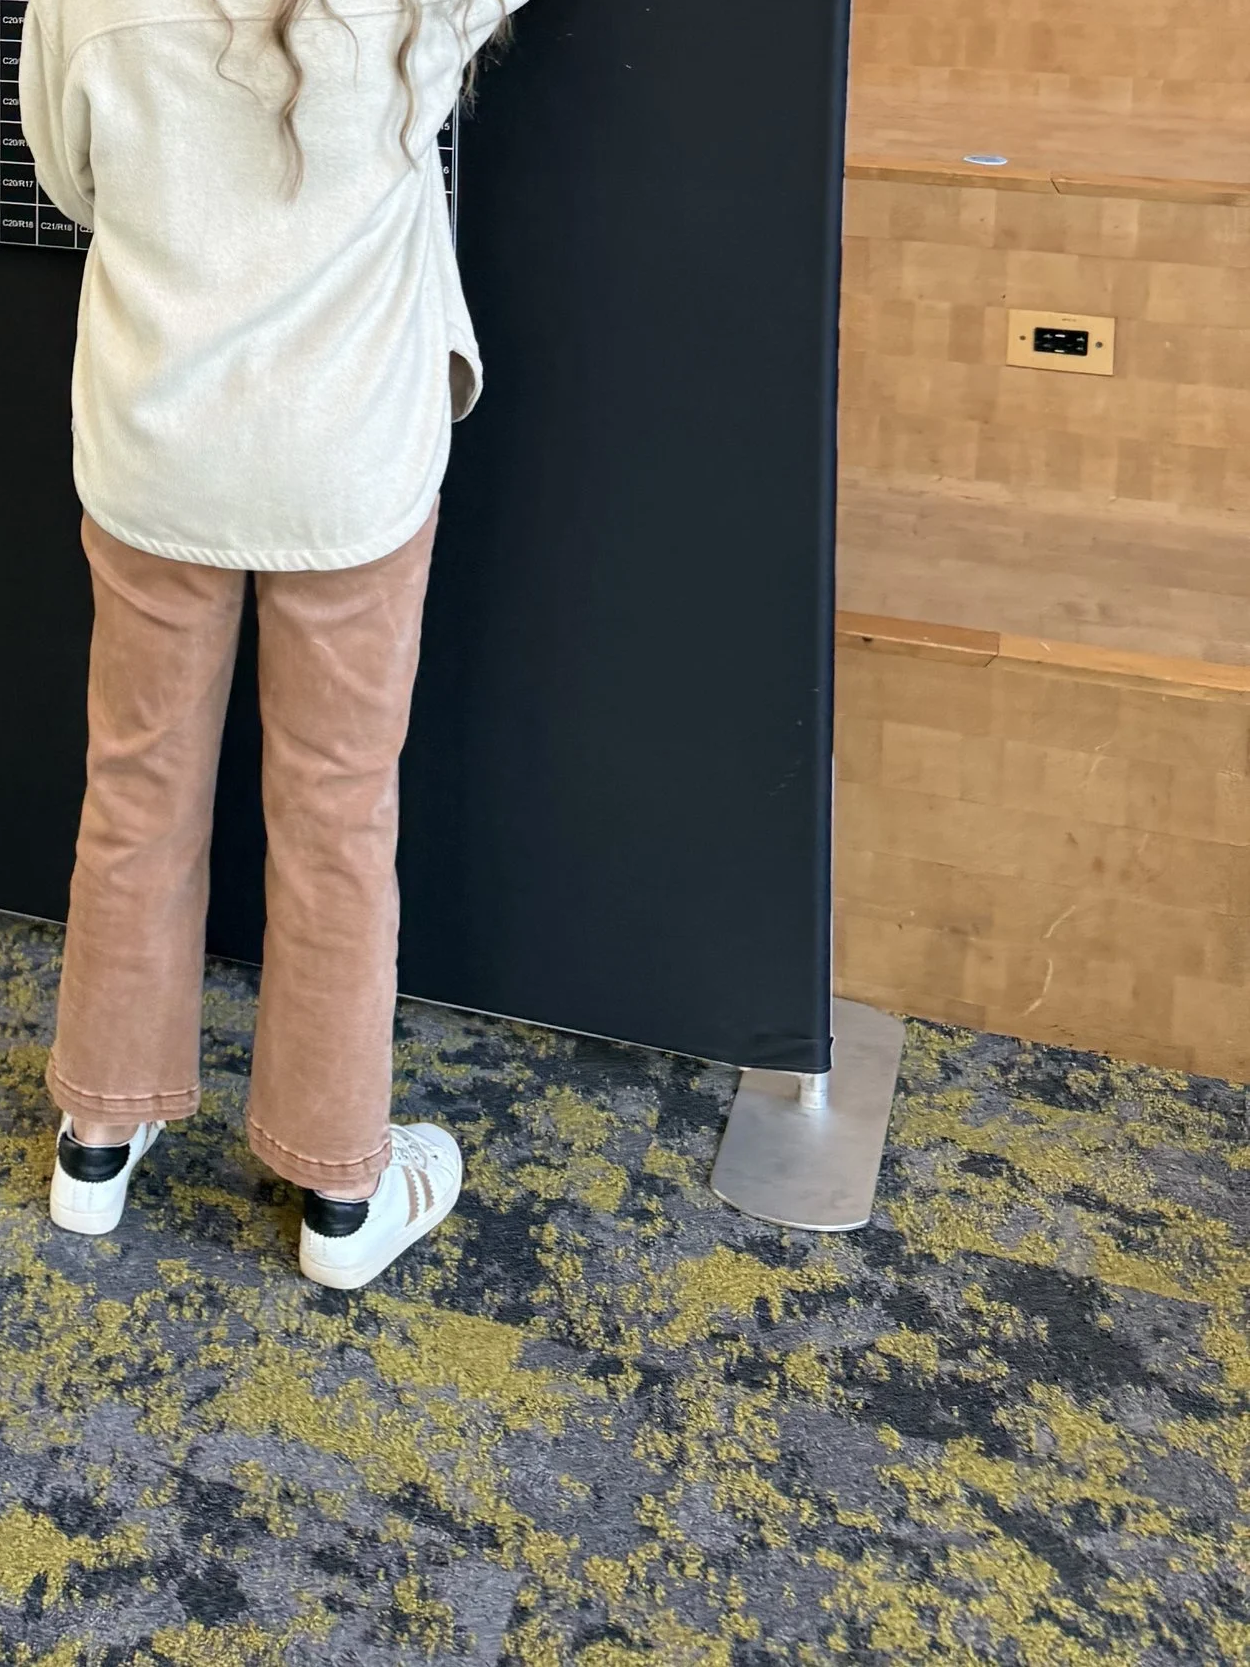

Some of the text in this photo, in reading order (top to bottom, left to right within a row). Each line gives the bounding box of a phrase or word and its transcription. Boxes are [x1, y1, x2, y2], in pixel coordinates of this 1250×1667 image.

[2, 178, 35, 188] C20/R17
[2, 218, 34, 229] C20/R18
[40, 221, 73, 232] C21/R18
